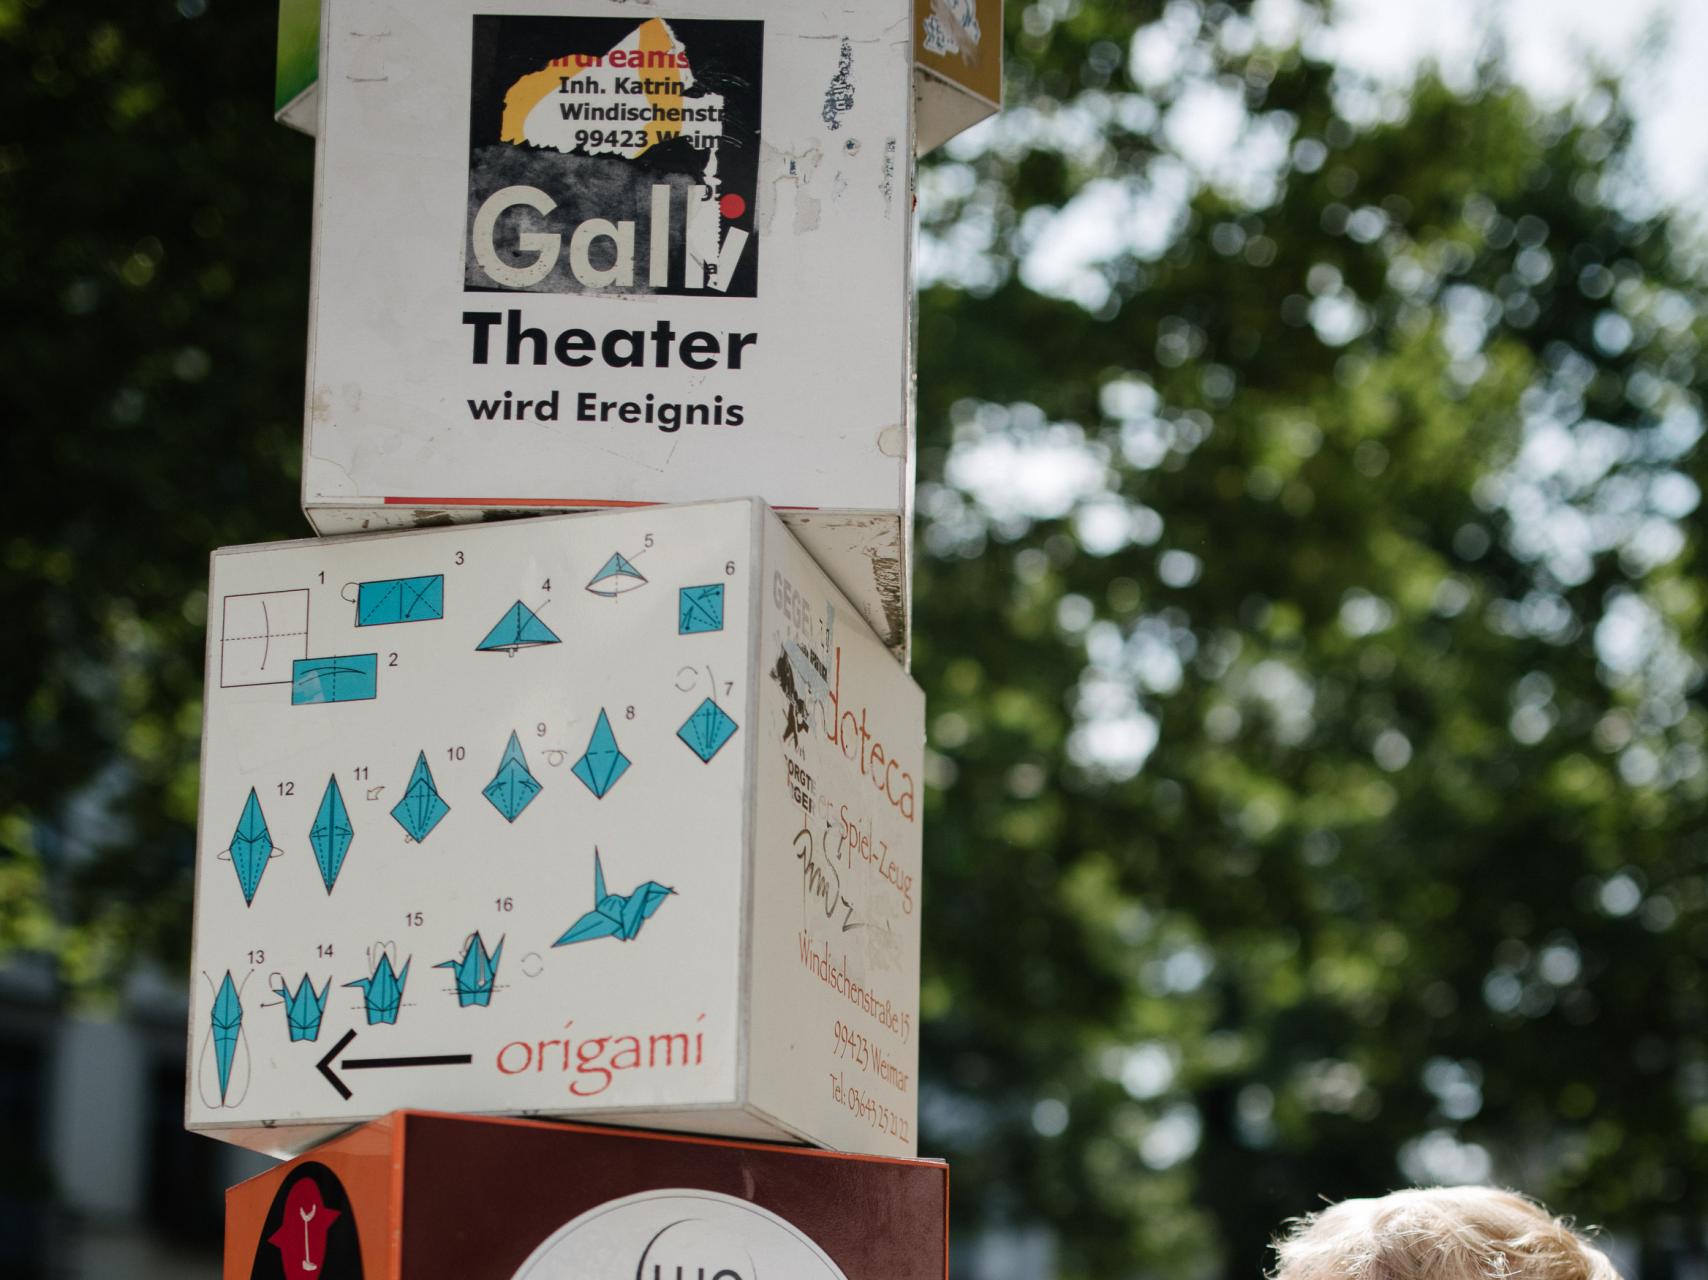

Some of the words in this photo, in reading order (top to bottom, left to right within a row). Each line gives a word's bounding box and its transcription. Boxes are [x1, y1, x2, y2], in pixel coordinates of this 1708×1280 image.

[559, 77, 606, 95] Inh.
[614, 77, 685, 95] Katrin
[574, 130, 648, 148] 99423
[462, 309, 758, 370] Theater
[467, 390, 559, 421] wird
[576, 392, 744, 433] Ereignis
[644, 533, 654, 548] 5
[455, 551, 464, 565] 3
[725, 561, 735, 575] 6
[318, 571, 325, 584] 1
[541, 578, 551, 592] 4
[389, 653, 398, 666] 2
[724, 681, 734, 695] 7
[625, 706, 635, 720] 8
[537, 723, 547, 737] 9
[447, 747, 466, 762] 10
[353, 768, 369, 781] 11
[277, 782, 295, 796] 12
[841, 805, 912, 914] Spiel-Zeug
[495, 898, 513, 912] 16
[405, 913, 423, 927] 15
[247, 950, 265, 965] 13
[316, 944, 334, 958] 14
[799, 931, 898, 1033] Windischenstraße
[497, 1013, 706, 1096] origami
[833, 1020, 869, 1072] 99423
[871, 1043, 909, 1093] Weimar
[829, 1071, 846, 1105] Tel:
[848, 1087, 876, 1128] 03643
